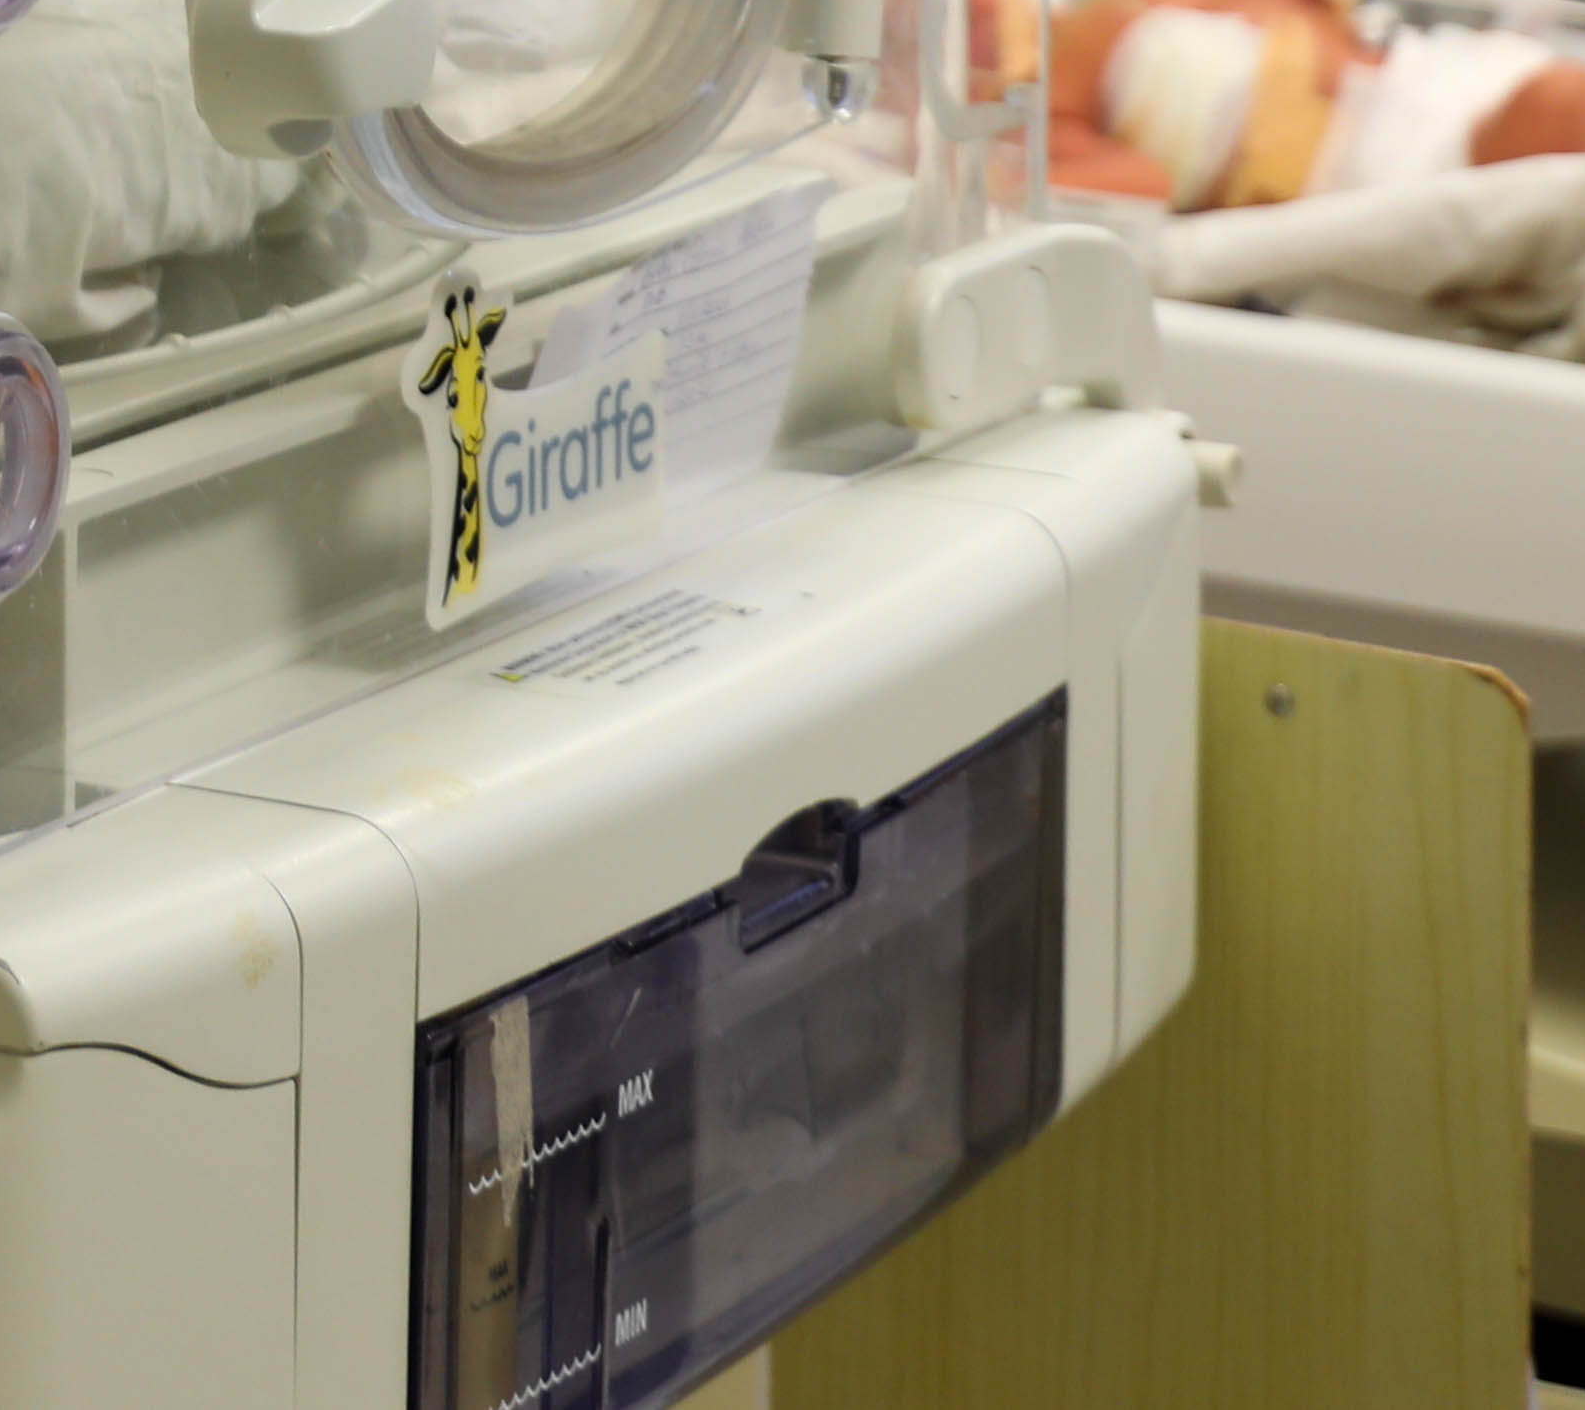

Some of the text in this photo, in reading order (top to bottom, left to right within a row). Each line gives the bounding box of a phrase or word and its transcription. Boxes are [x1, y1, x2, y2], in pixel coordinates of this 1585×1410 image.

[486, 379, 656, 528] Giraffe
[618, 1069, 655, 1118] MAX
[614, 1297, 649, 1346] MIN
